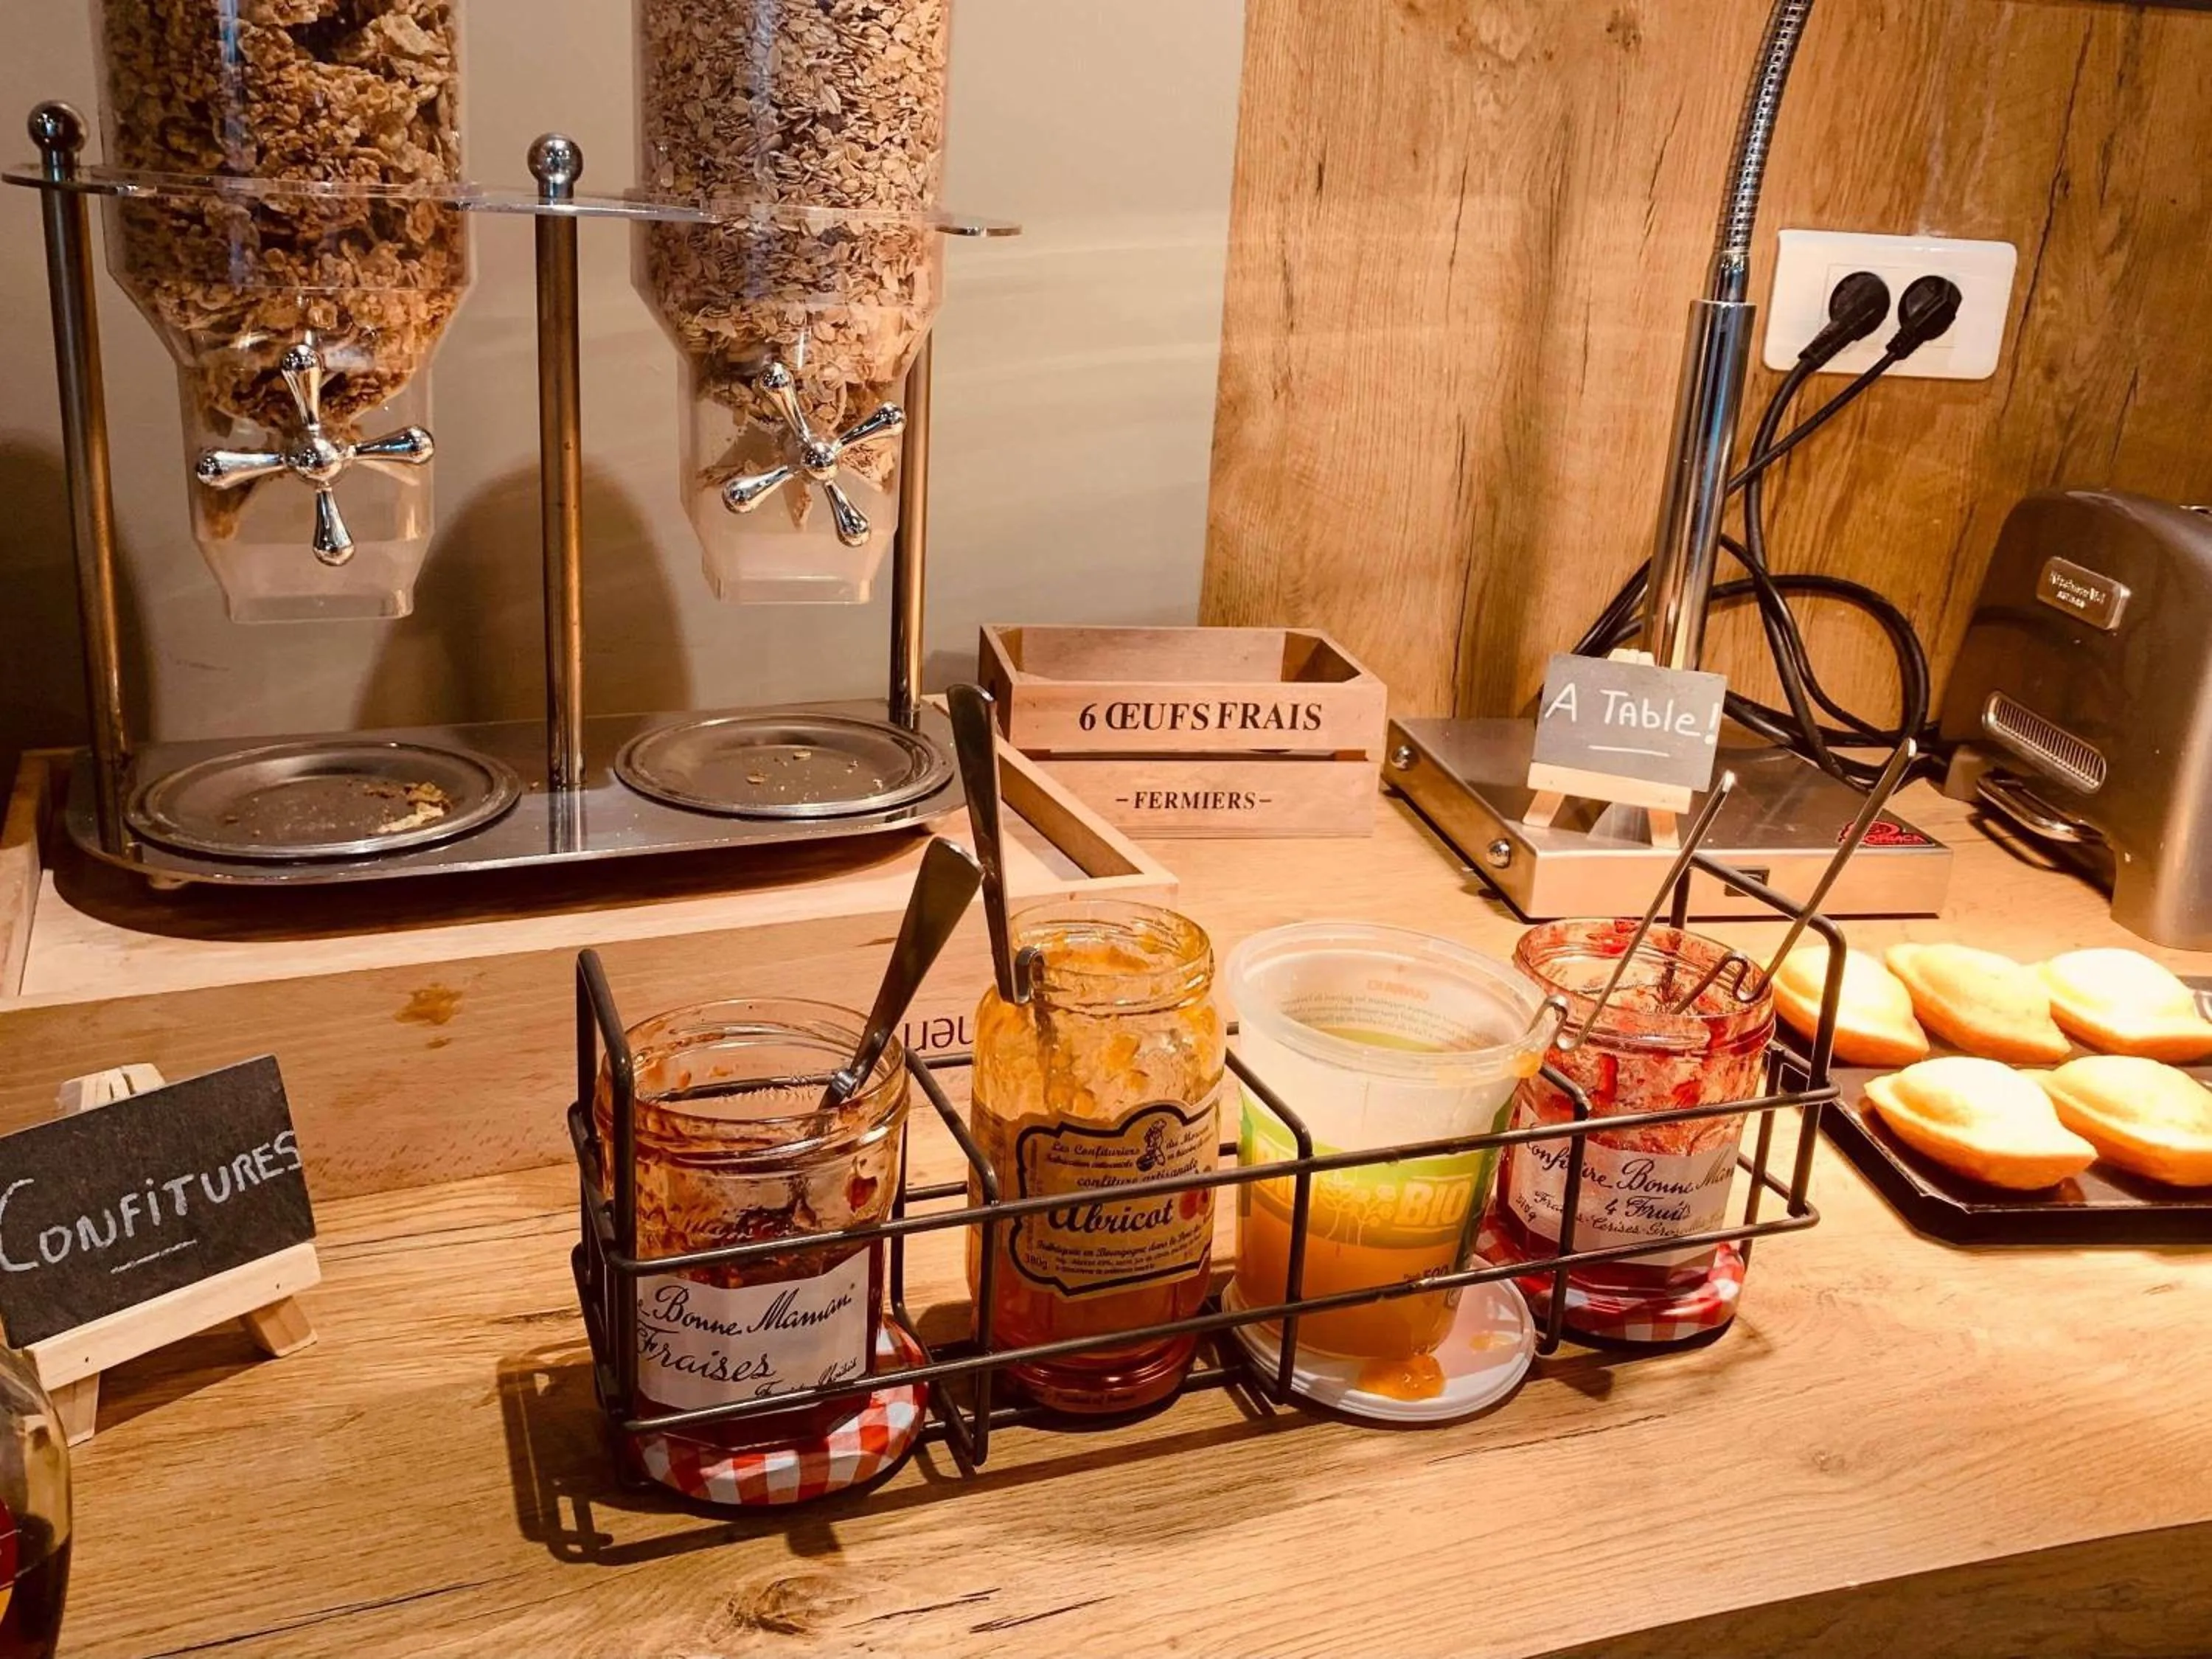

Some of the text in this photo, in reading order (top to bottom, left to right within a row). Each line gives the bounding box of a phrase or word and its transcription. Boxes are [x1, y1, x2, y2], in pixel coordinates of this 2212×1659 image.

[1079, 700, 1323, 731] 6 ŒUFS FRAIS
[1545, 682, 1577, 723] A
[1394, 1180, 1470, 1225] BIO
[653, 1285, 742, 1335] Bonne
[637, 1320, 777, 1382] Fraises
